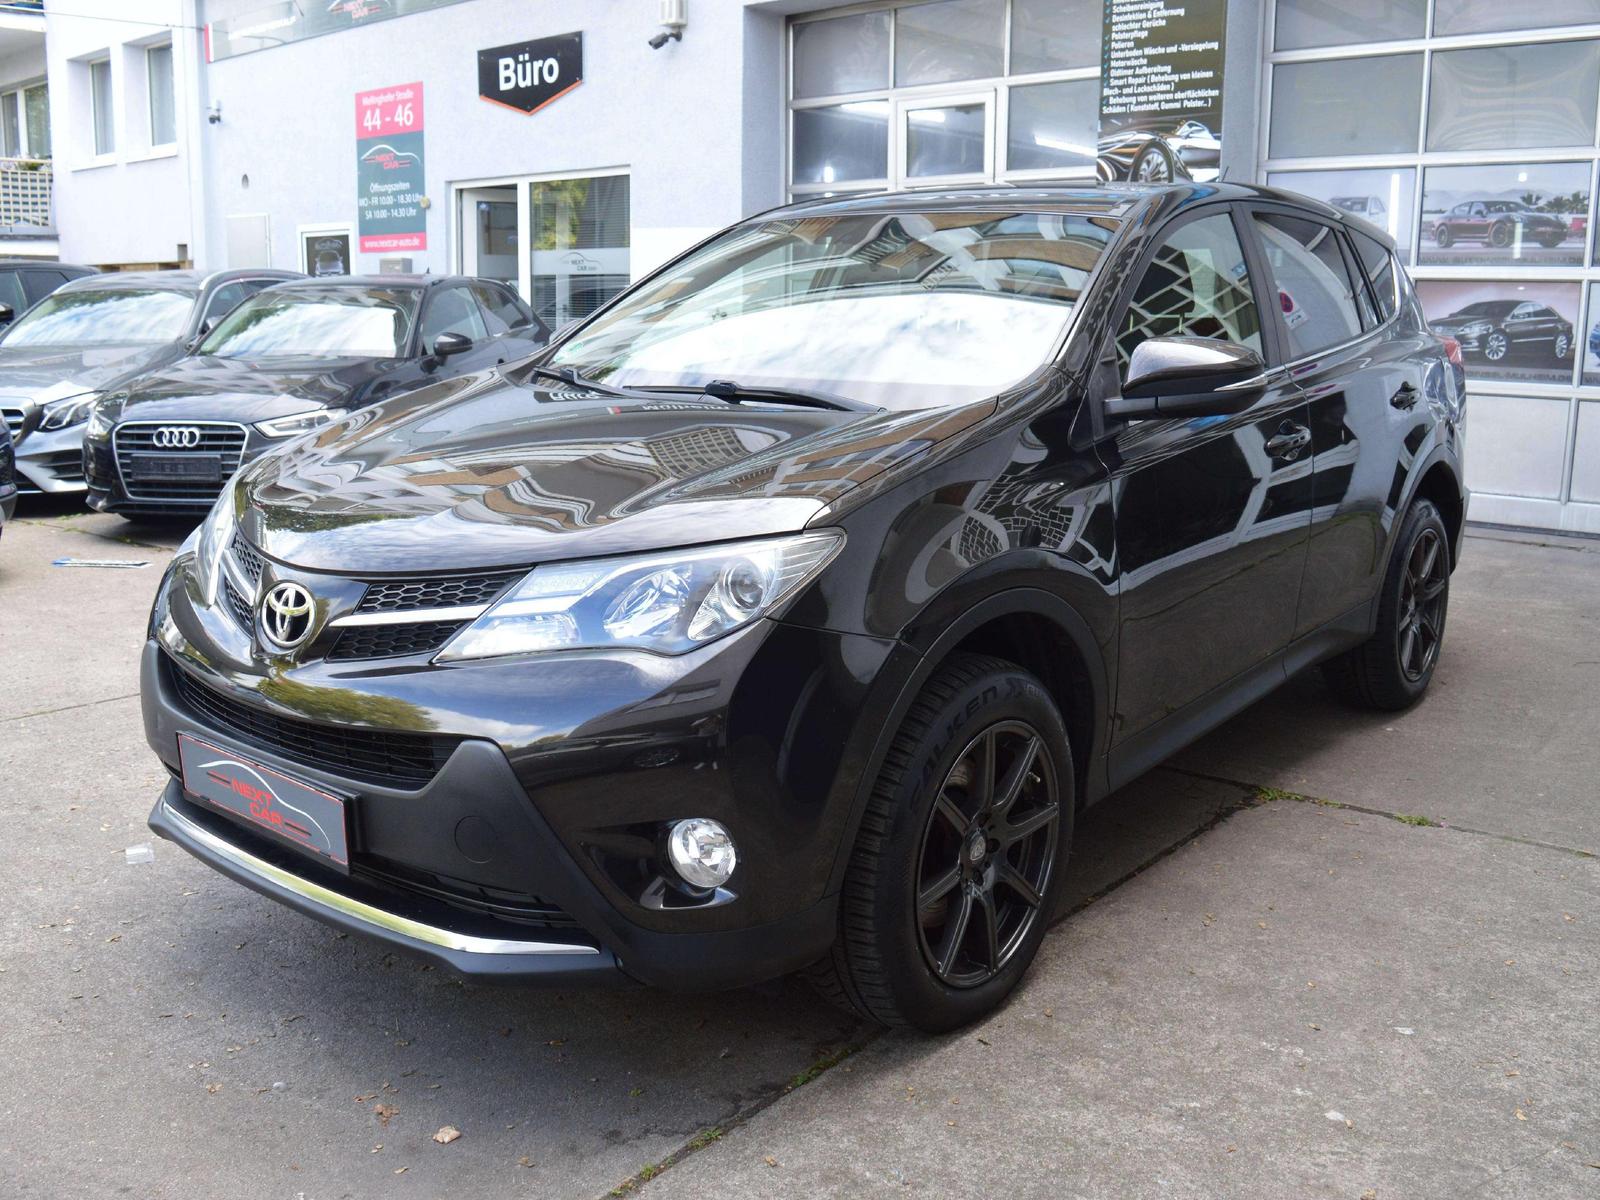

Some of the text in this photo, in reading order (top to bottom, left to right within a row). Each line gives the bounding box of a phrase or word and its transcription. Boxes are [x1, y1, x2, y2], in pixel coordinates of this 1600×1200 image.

[1153, 8, 1185, 18] Entfernung
[1112, 19, 1166, 31] schlechter Gerüche
[1111, 31, 1148, 40] Polsterpflege
[1111, 41, 1134, 49] Polieren
[1111, 49, 1143, 59] Unterboden
[1143, 46, 1165, 55] Wäsche
[1166, 44, 1177, 53] und
[1110, 58, 1147, 67] Motorwäsche
[498, 53, 559, 91] Büro
[1110, 65, 1171, 77] Oldtimer Aufbereitung
[1110, 77, 1127, 86] Smart
[1128, 75, 1146, 85] Repair
[1151, 73, 1179, 83] Behebung
[1180, 72, 1191, 80] von
[1191, 70, 1213, 79] kleinen
[1103, 87, 1121, 96] Blech-
[1122, 85, 1133, 94] und
[1134, 83, 1170, 93] Lackschäden
[1109, 95, 1136, 105] Behebung
[1137, 94, 1148, 102] von
[1149, 92, 1174, 101] weiteren
[1102, 105, 1126, 114] Schäden
[363, 108, 382, 132] 44
[394, 102, 414, 127] 46
[369, 181, 410, 194] Öffnungszeiten
[371, 197, 379, 206] FR
[379, 195, 393, 205] 10.00
[397, 193, 411, 204] 18.30
[365, 210, 372, 220] SA
[373, 208, 387, 219] 10.00
[391, 208, 405, 218] 14.30
[406, 206, 416, 217] Uhr
[231, 778, 272, 806] NEXT
[250, 802, 283, 825] CAR
